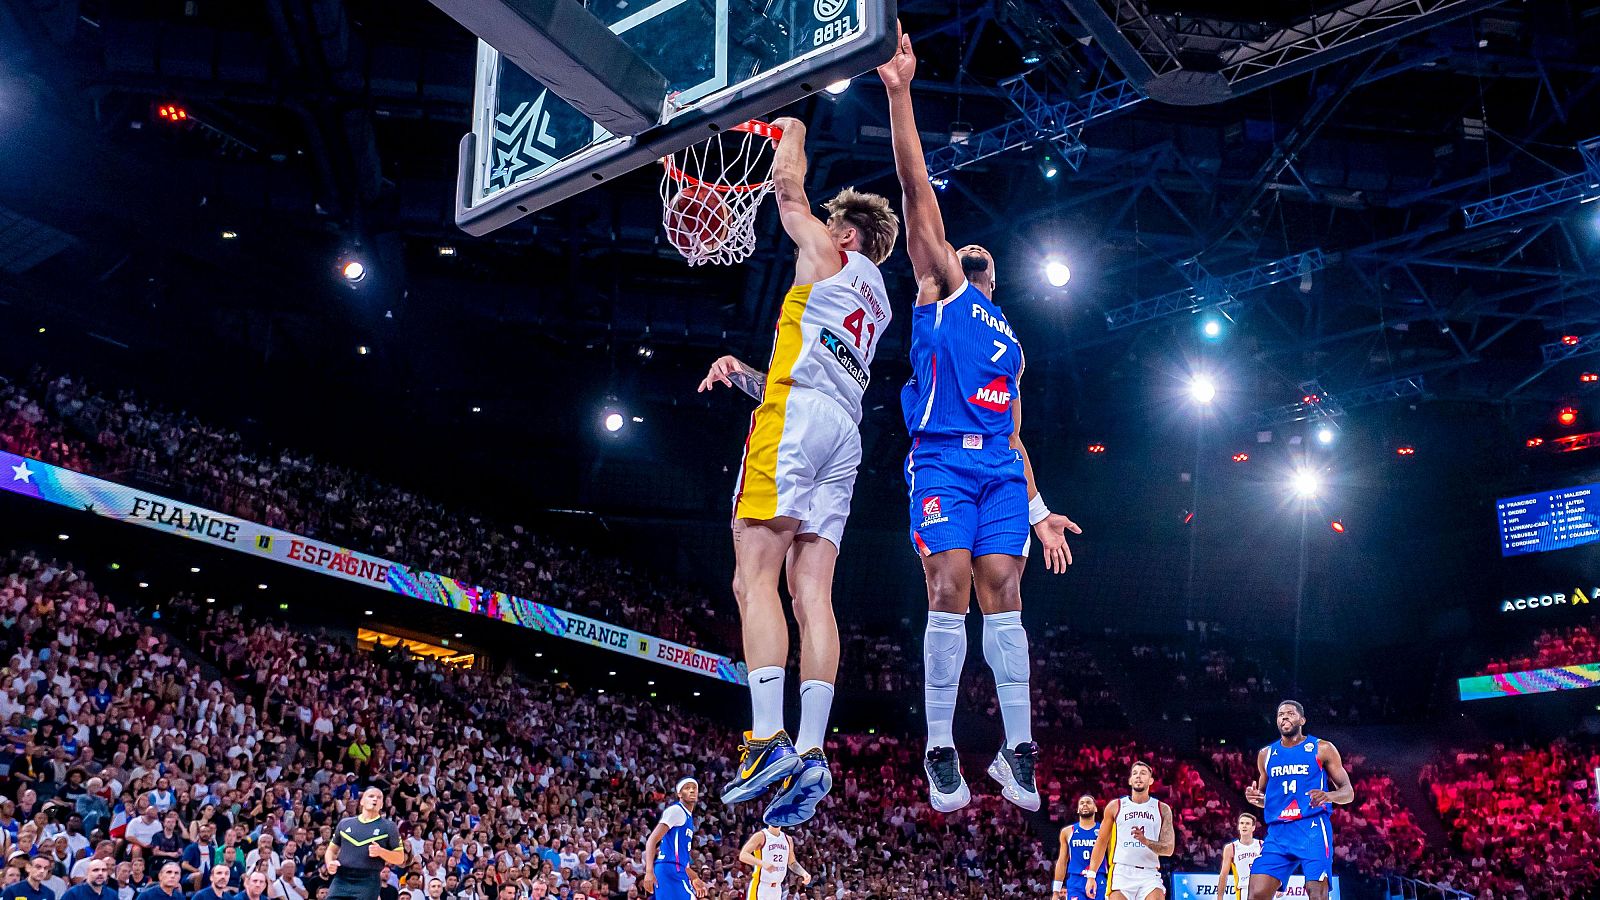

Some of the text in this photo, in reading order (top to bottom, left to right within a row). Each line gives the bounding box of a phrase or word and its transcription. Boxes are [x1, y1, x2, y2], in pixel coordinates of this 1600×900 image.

[842, 307, 876, 363] 41
[990, 340, 1008, 363] 7
[975, 387, 1012, 405] MAIF
[129, 497, 240, 544] FRANCE
[286, 539, 390, 584] ESPAGNE
[1502, 592, 1567, 612] ACCOR
[566, 617, 629, 649] FRANCE
[656, 643, 719, 674] ESPAGNE
[1270, 764, 1310, 778] FRANCE
[1281, 779, 1297, 795] 14
[1124, 810, 1155, 822] ESPAÑA
[1280, 808, 1302, 817] MAIF
[773, 854, 783, 863] 22
[1082, 850, 1091, 860] 0
